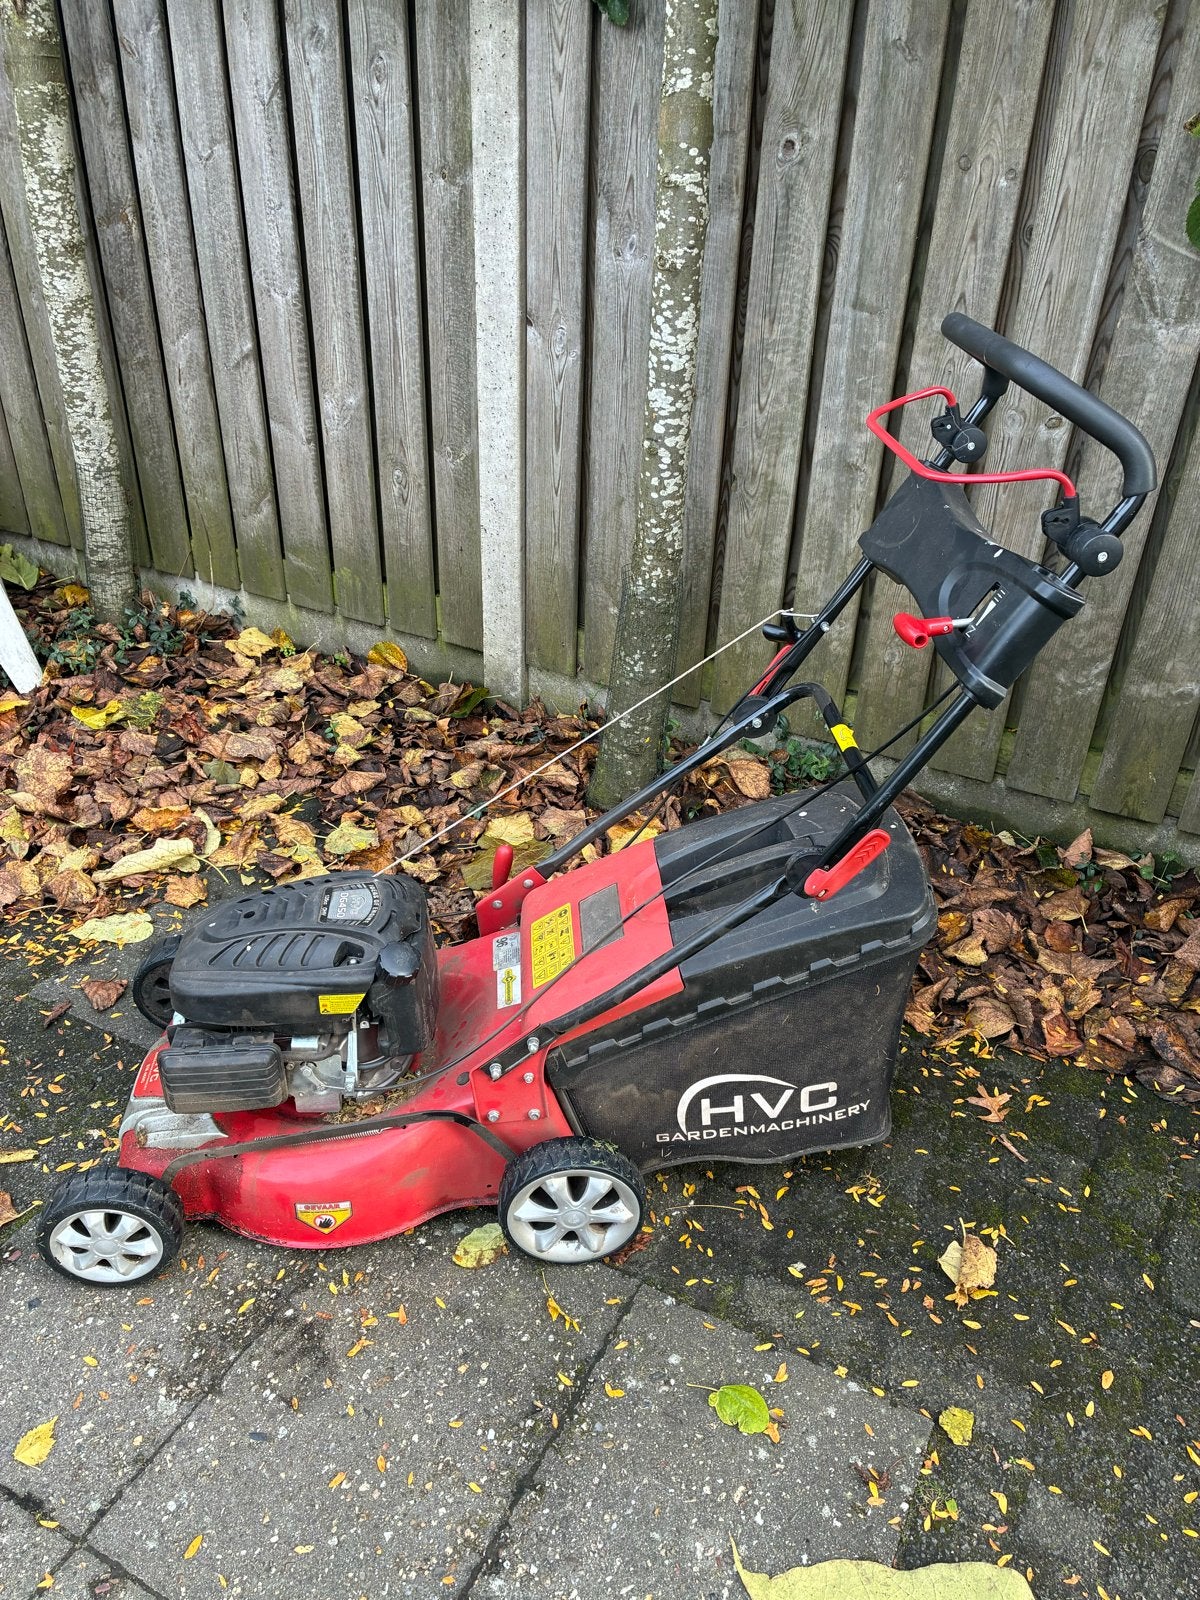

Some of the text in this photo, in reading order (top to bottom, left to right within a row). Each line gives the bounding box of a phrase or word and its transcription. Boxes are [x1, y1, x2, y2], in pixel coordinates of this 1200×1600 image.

[336, 892, 349, 918] DG450
[655, 1099, 871, 1143] GARDENMACHINERY
[701, 1081, 838, 1126] HVC
[303, 1203, 340, 1211] GEVAAR
